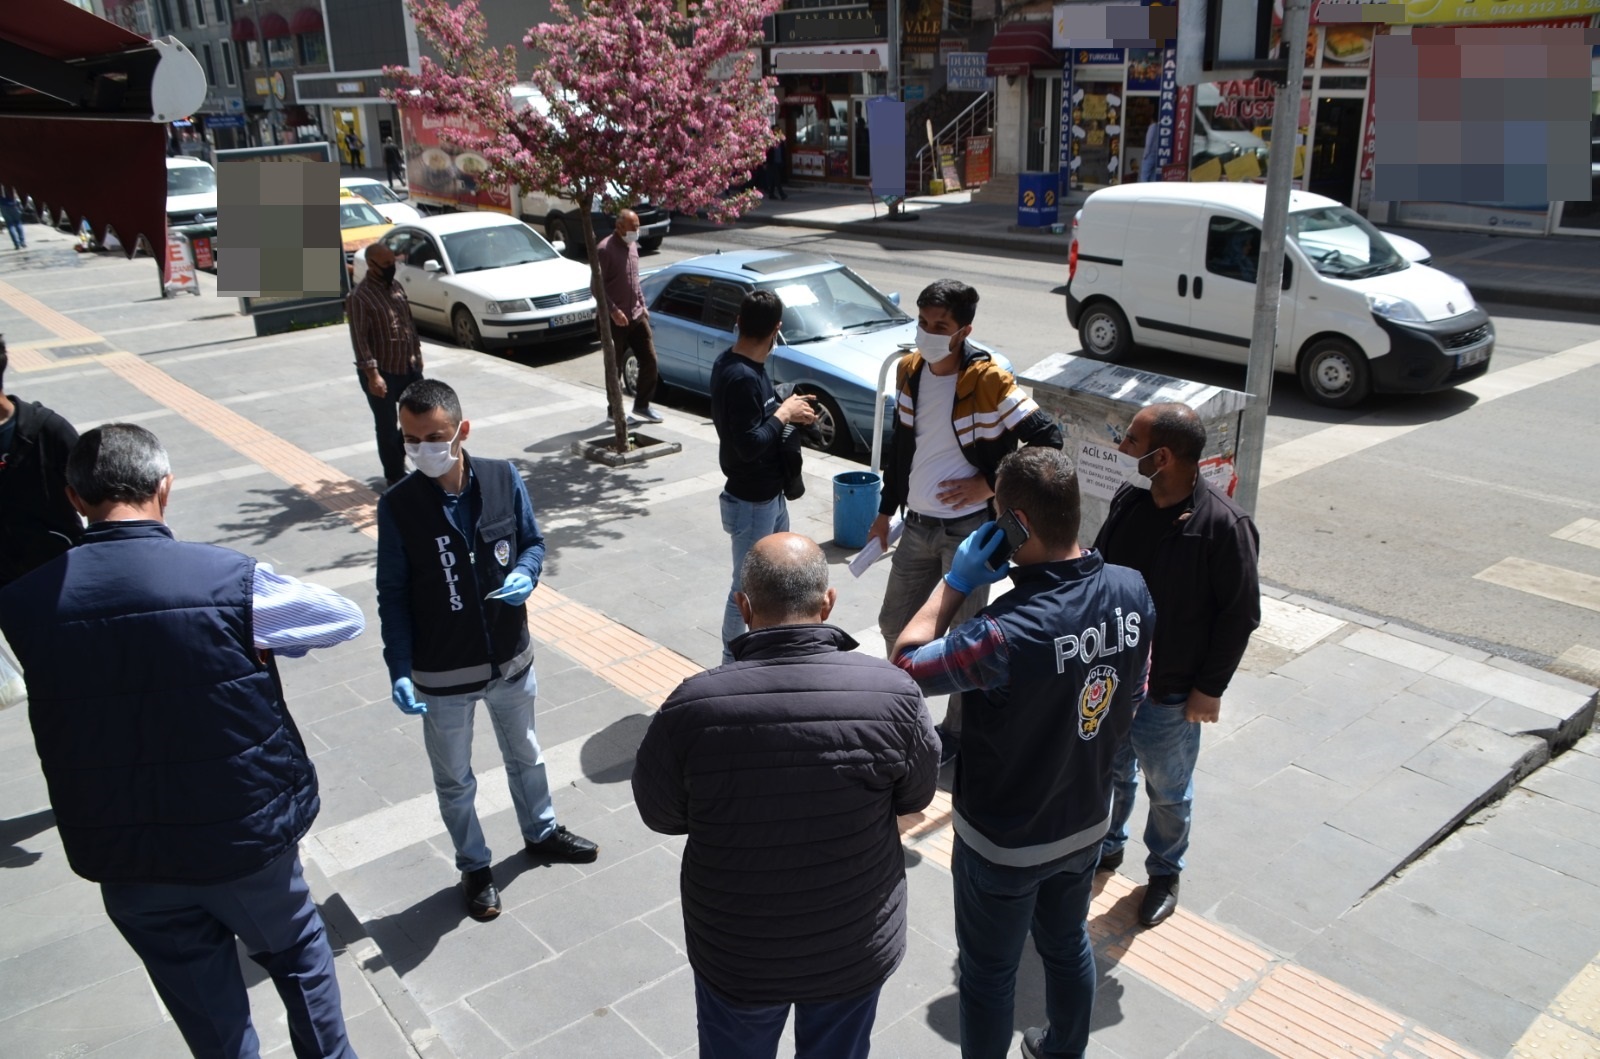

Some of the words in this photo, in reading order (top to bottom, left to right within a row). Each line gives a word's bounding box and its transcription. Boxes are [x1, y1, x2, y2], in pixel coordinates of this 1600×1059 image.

[905, 20, 941, 34] VALE
[1162, 49, 1176, 111] FATURA
[1242, 101, 1275, 118] UST
[1082, 446, 1101, 459] ACİL
[435, 535, 464, 611] POLİS
[1054, 607, 1141, 674] POLİS
